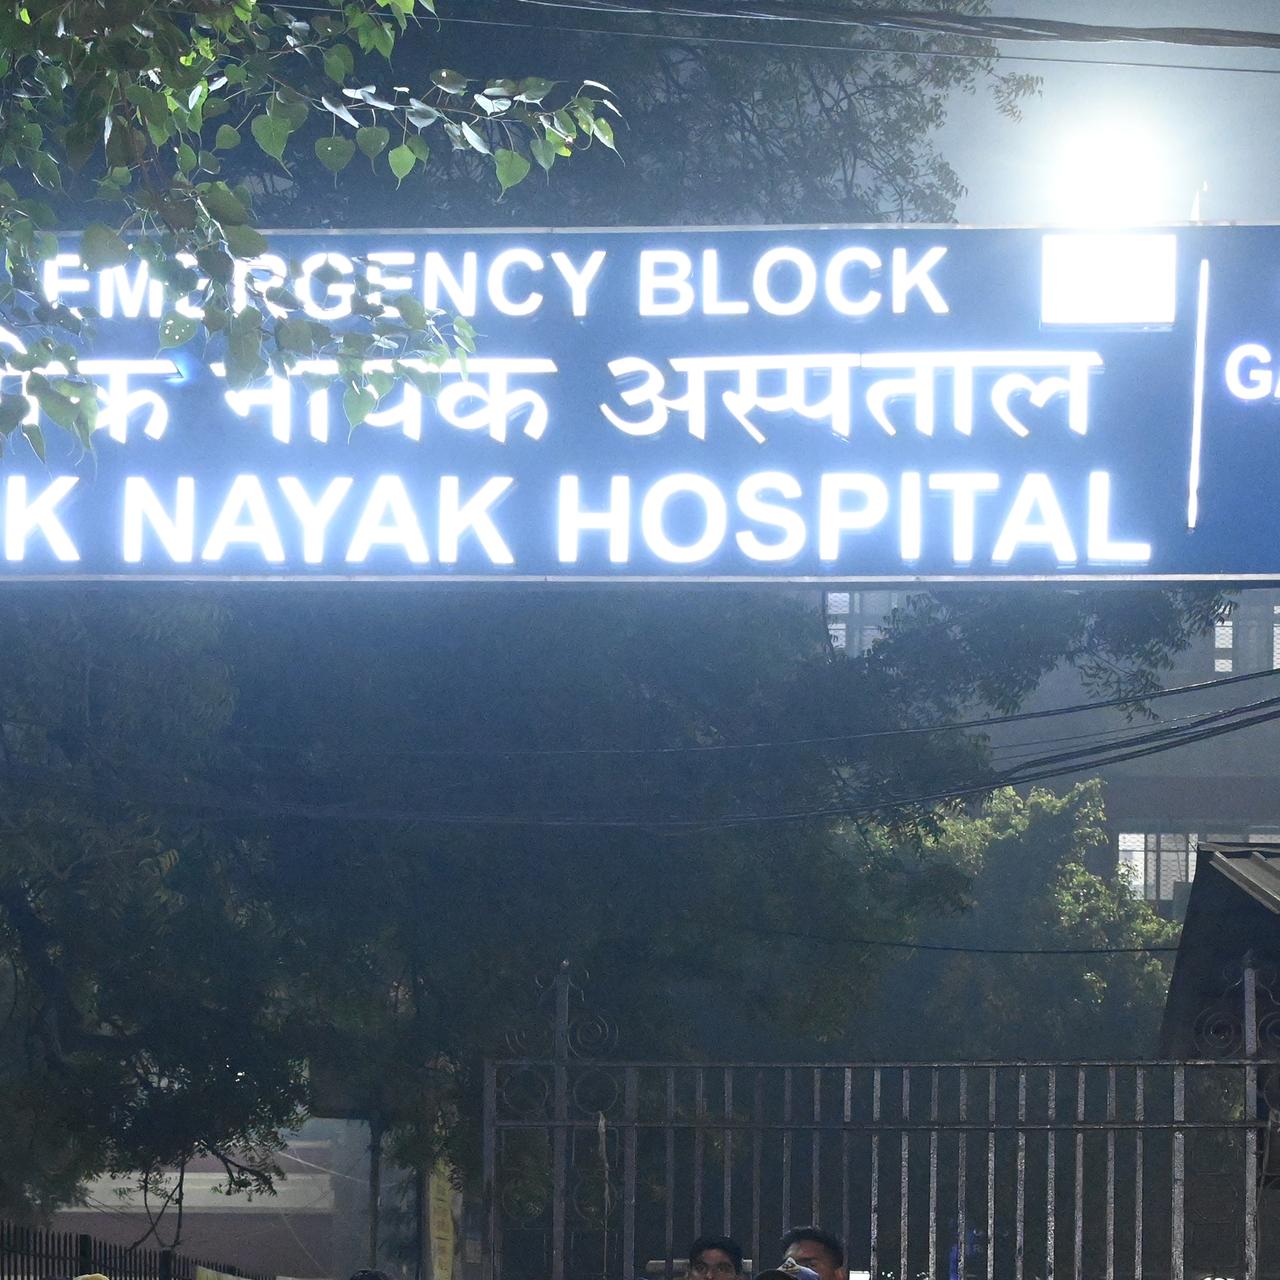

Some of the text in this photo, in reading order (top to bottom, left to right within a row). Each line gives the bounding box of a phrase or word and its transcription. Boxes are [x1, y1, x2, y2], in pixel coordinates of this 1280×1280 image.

[638, 246, 950, 318] BLOCK
[600, 350, 1104, 443] अस्पताल
[123, 473, 515, 564] NAYAK
[557, 470, 1152, 564] HOSPITAL
